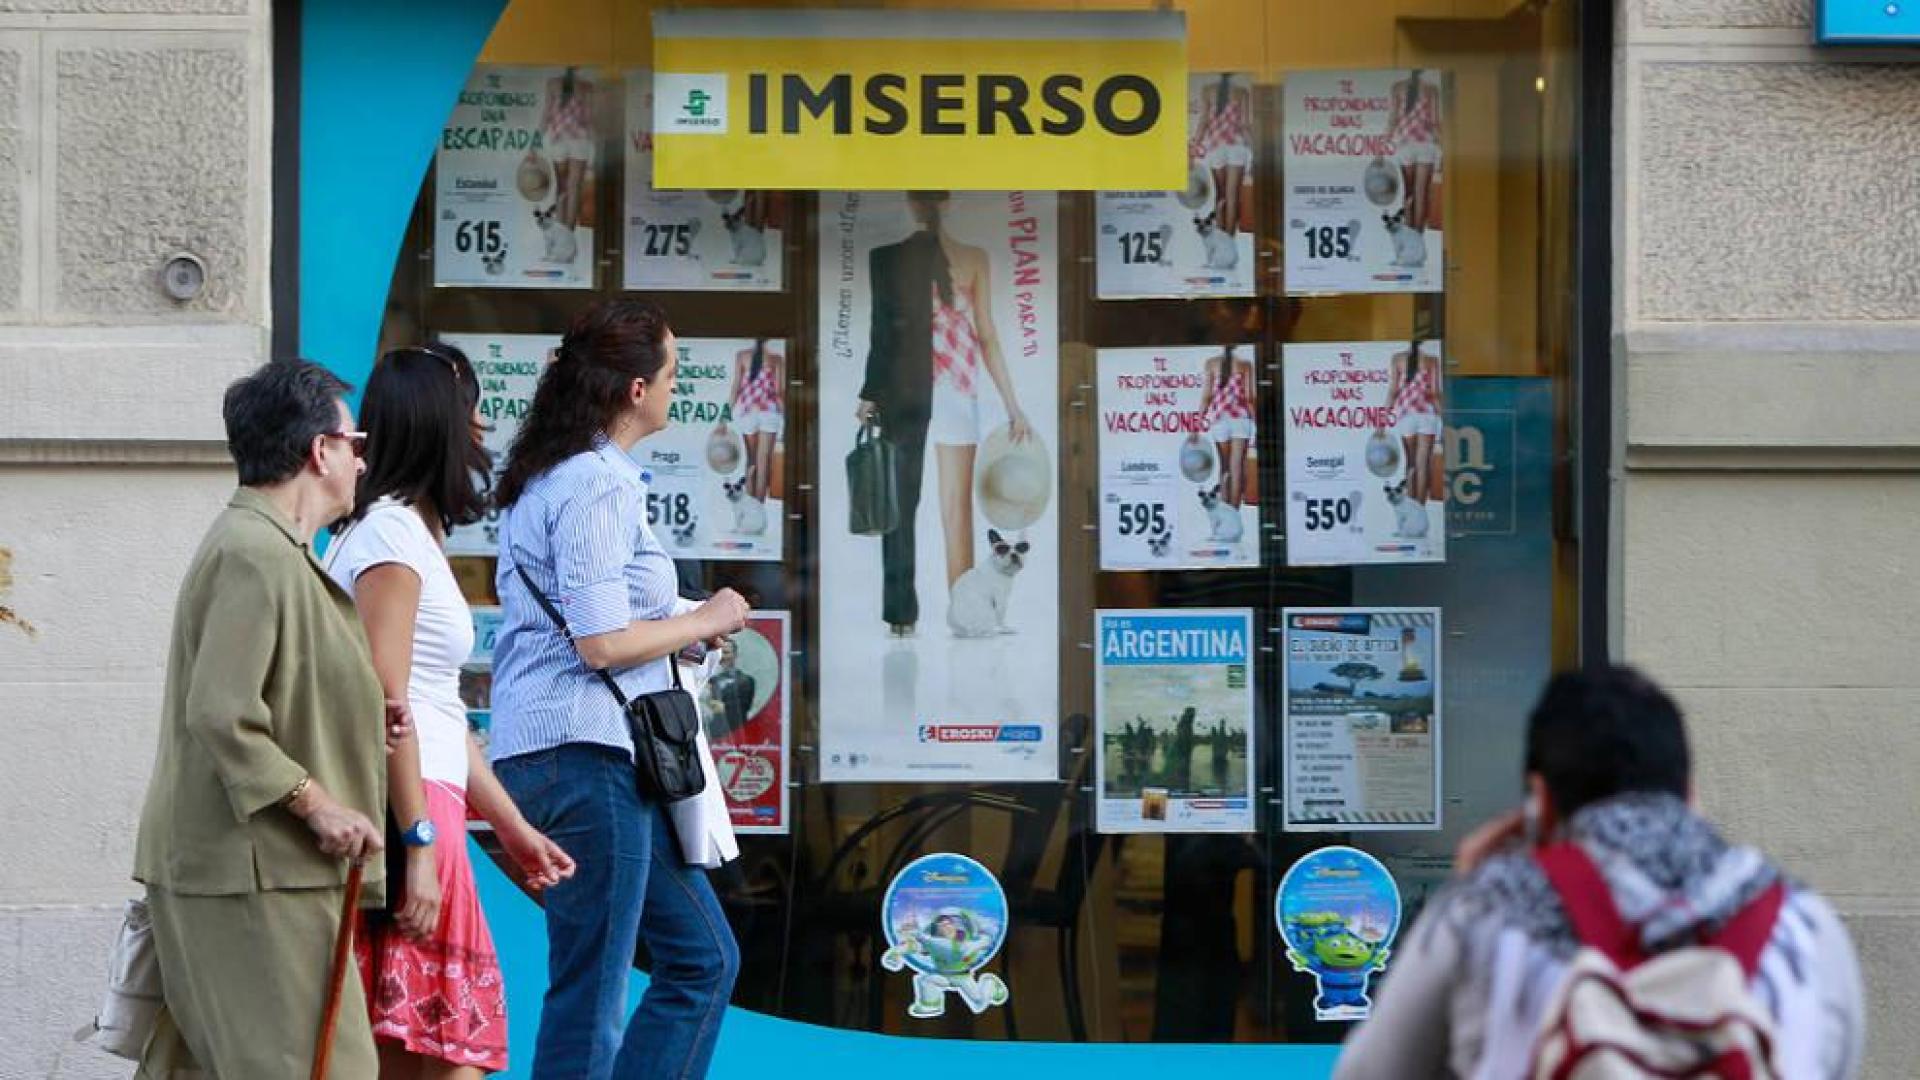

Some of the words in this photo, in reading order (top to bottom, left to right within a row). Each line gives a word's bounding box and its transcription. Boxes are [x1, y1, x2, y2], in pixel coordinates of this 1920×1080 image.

[748, 73, 1161, 135] IMSERSO
[443, 127, 544, 150] ESCAPADA
[1289, 133, 1397, 156] VACACIONES
[456, 220, 500, 253] 615
[643, 224, 691, 257] 275
[1007, 216, 1041, 287] PLAN
[1119, 232, 1162, 265] 125
[1304, 226, 1350, 259] 185
[1015, 292, 1038, 338] PARA
[667, 400, 733, 423] APADA
[1104, 410, 1211, 433] VACACIONES
[1289, 406, 1397, 428] VACACIONES
[647, 493, 689, 526] 518
[1118, 503, 1165, 535] 595
[1305, 497, 1351, 531] 550
[1104, 629, 1244, 658] ARGENTINA
